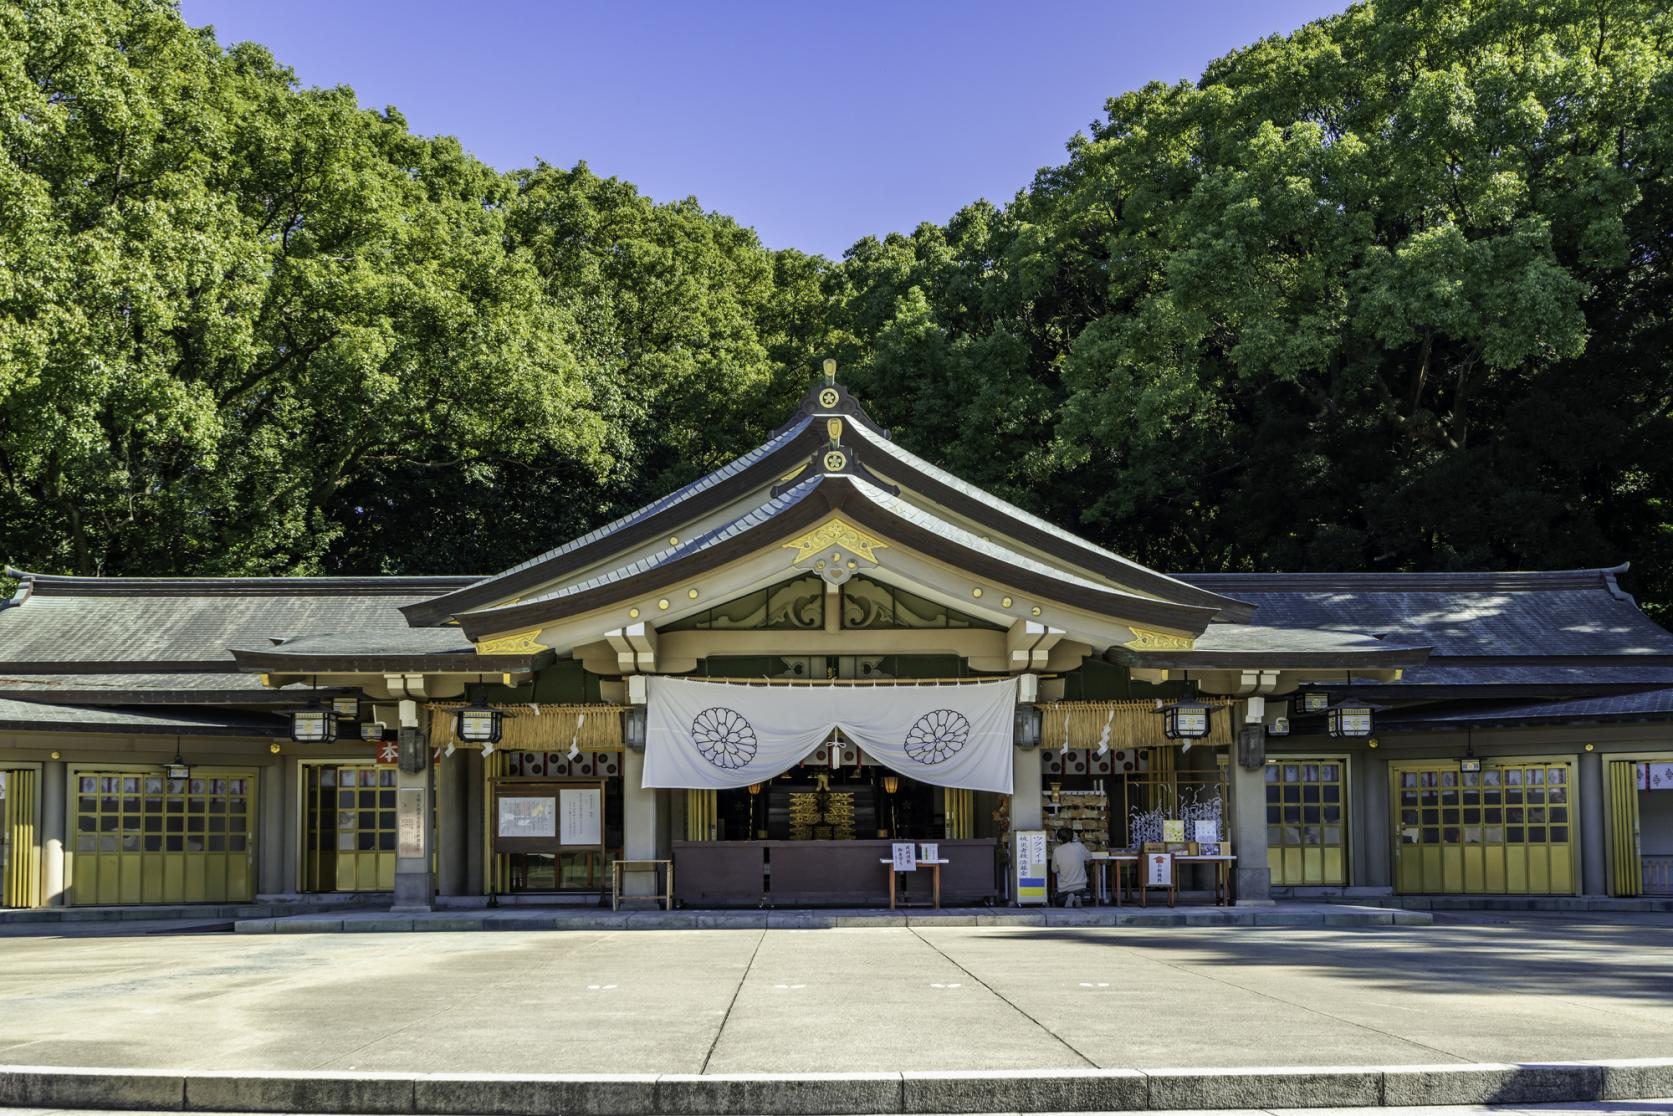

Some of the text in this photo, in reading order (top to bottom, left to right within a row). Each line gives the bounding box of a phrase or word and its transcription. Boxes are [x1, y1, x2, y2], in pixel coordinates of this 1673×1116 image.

[1033, 836, 1043, 864] ウクライナ
